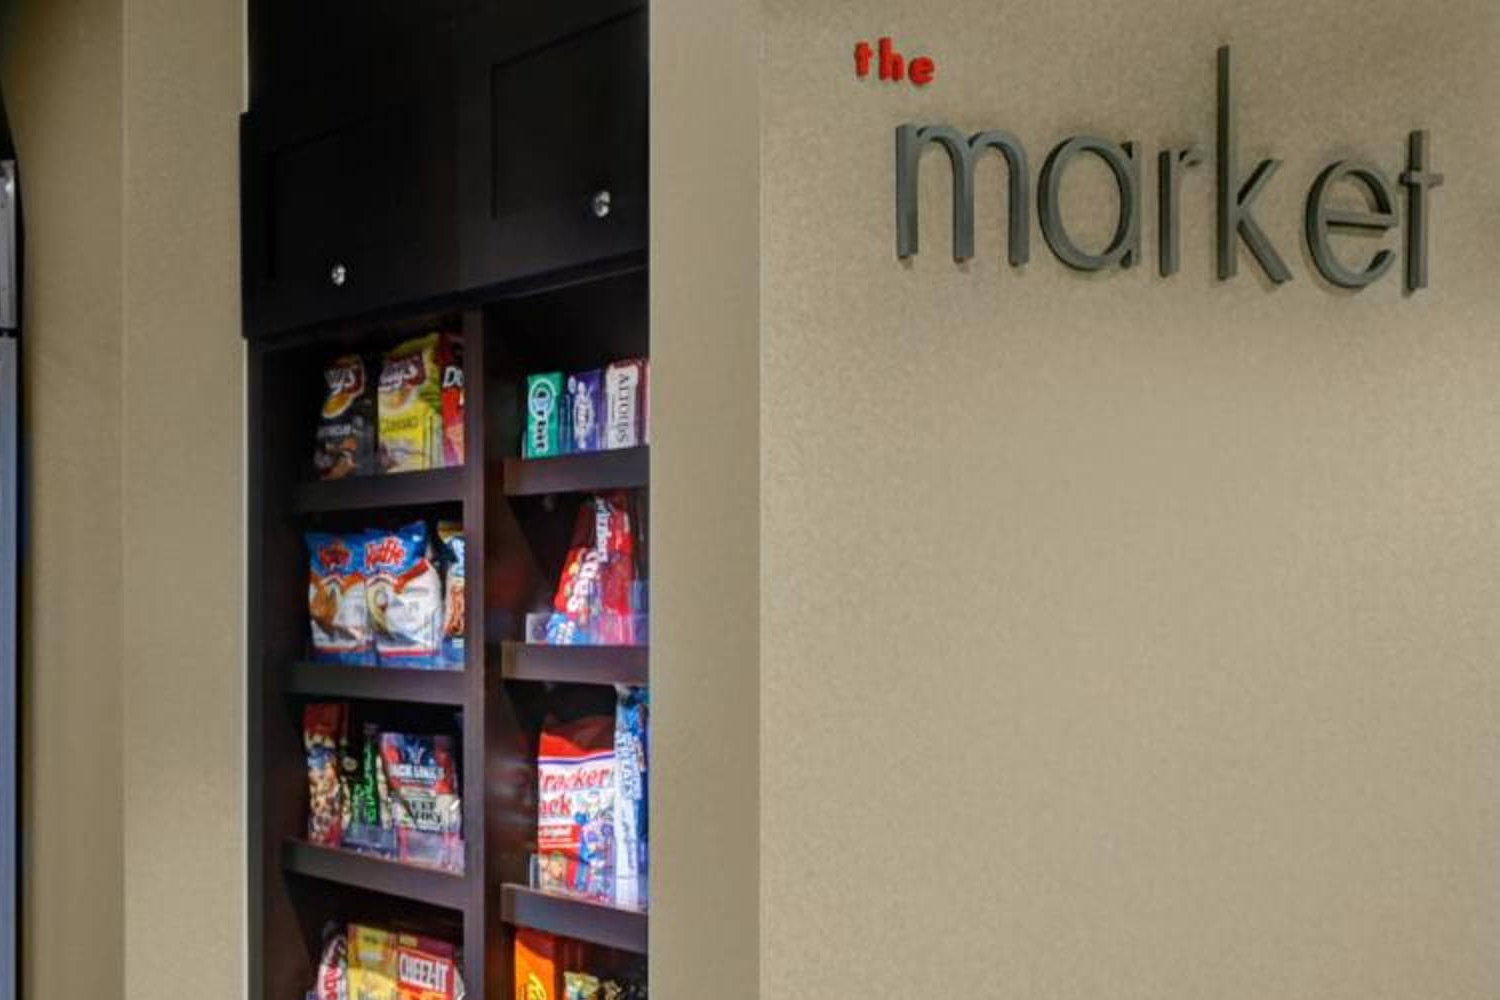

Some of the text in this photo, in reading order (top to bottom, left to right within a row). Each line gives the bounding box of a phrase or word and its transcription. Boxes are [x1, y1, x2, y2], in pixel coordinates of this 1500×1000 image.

[853, 36, 936, 85] the
[894, 44, 1445, 296] market
[539, 792, 573, 817] ack
